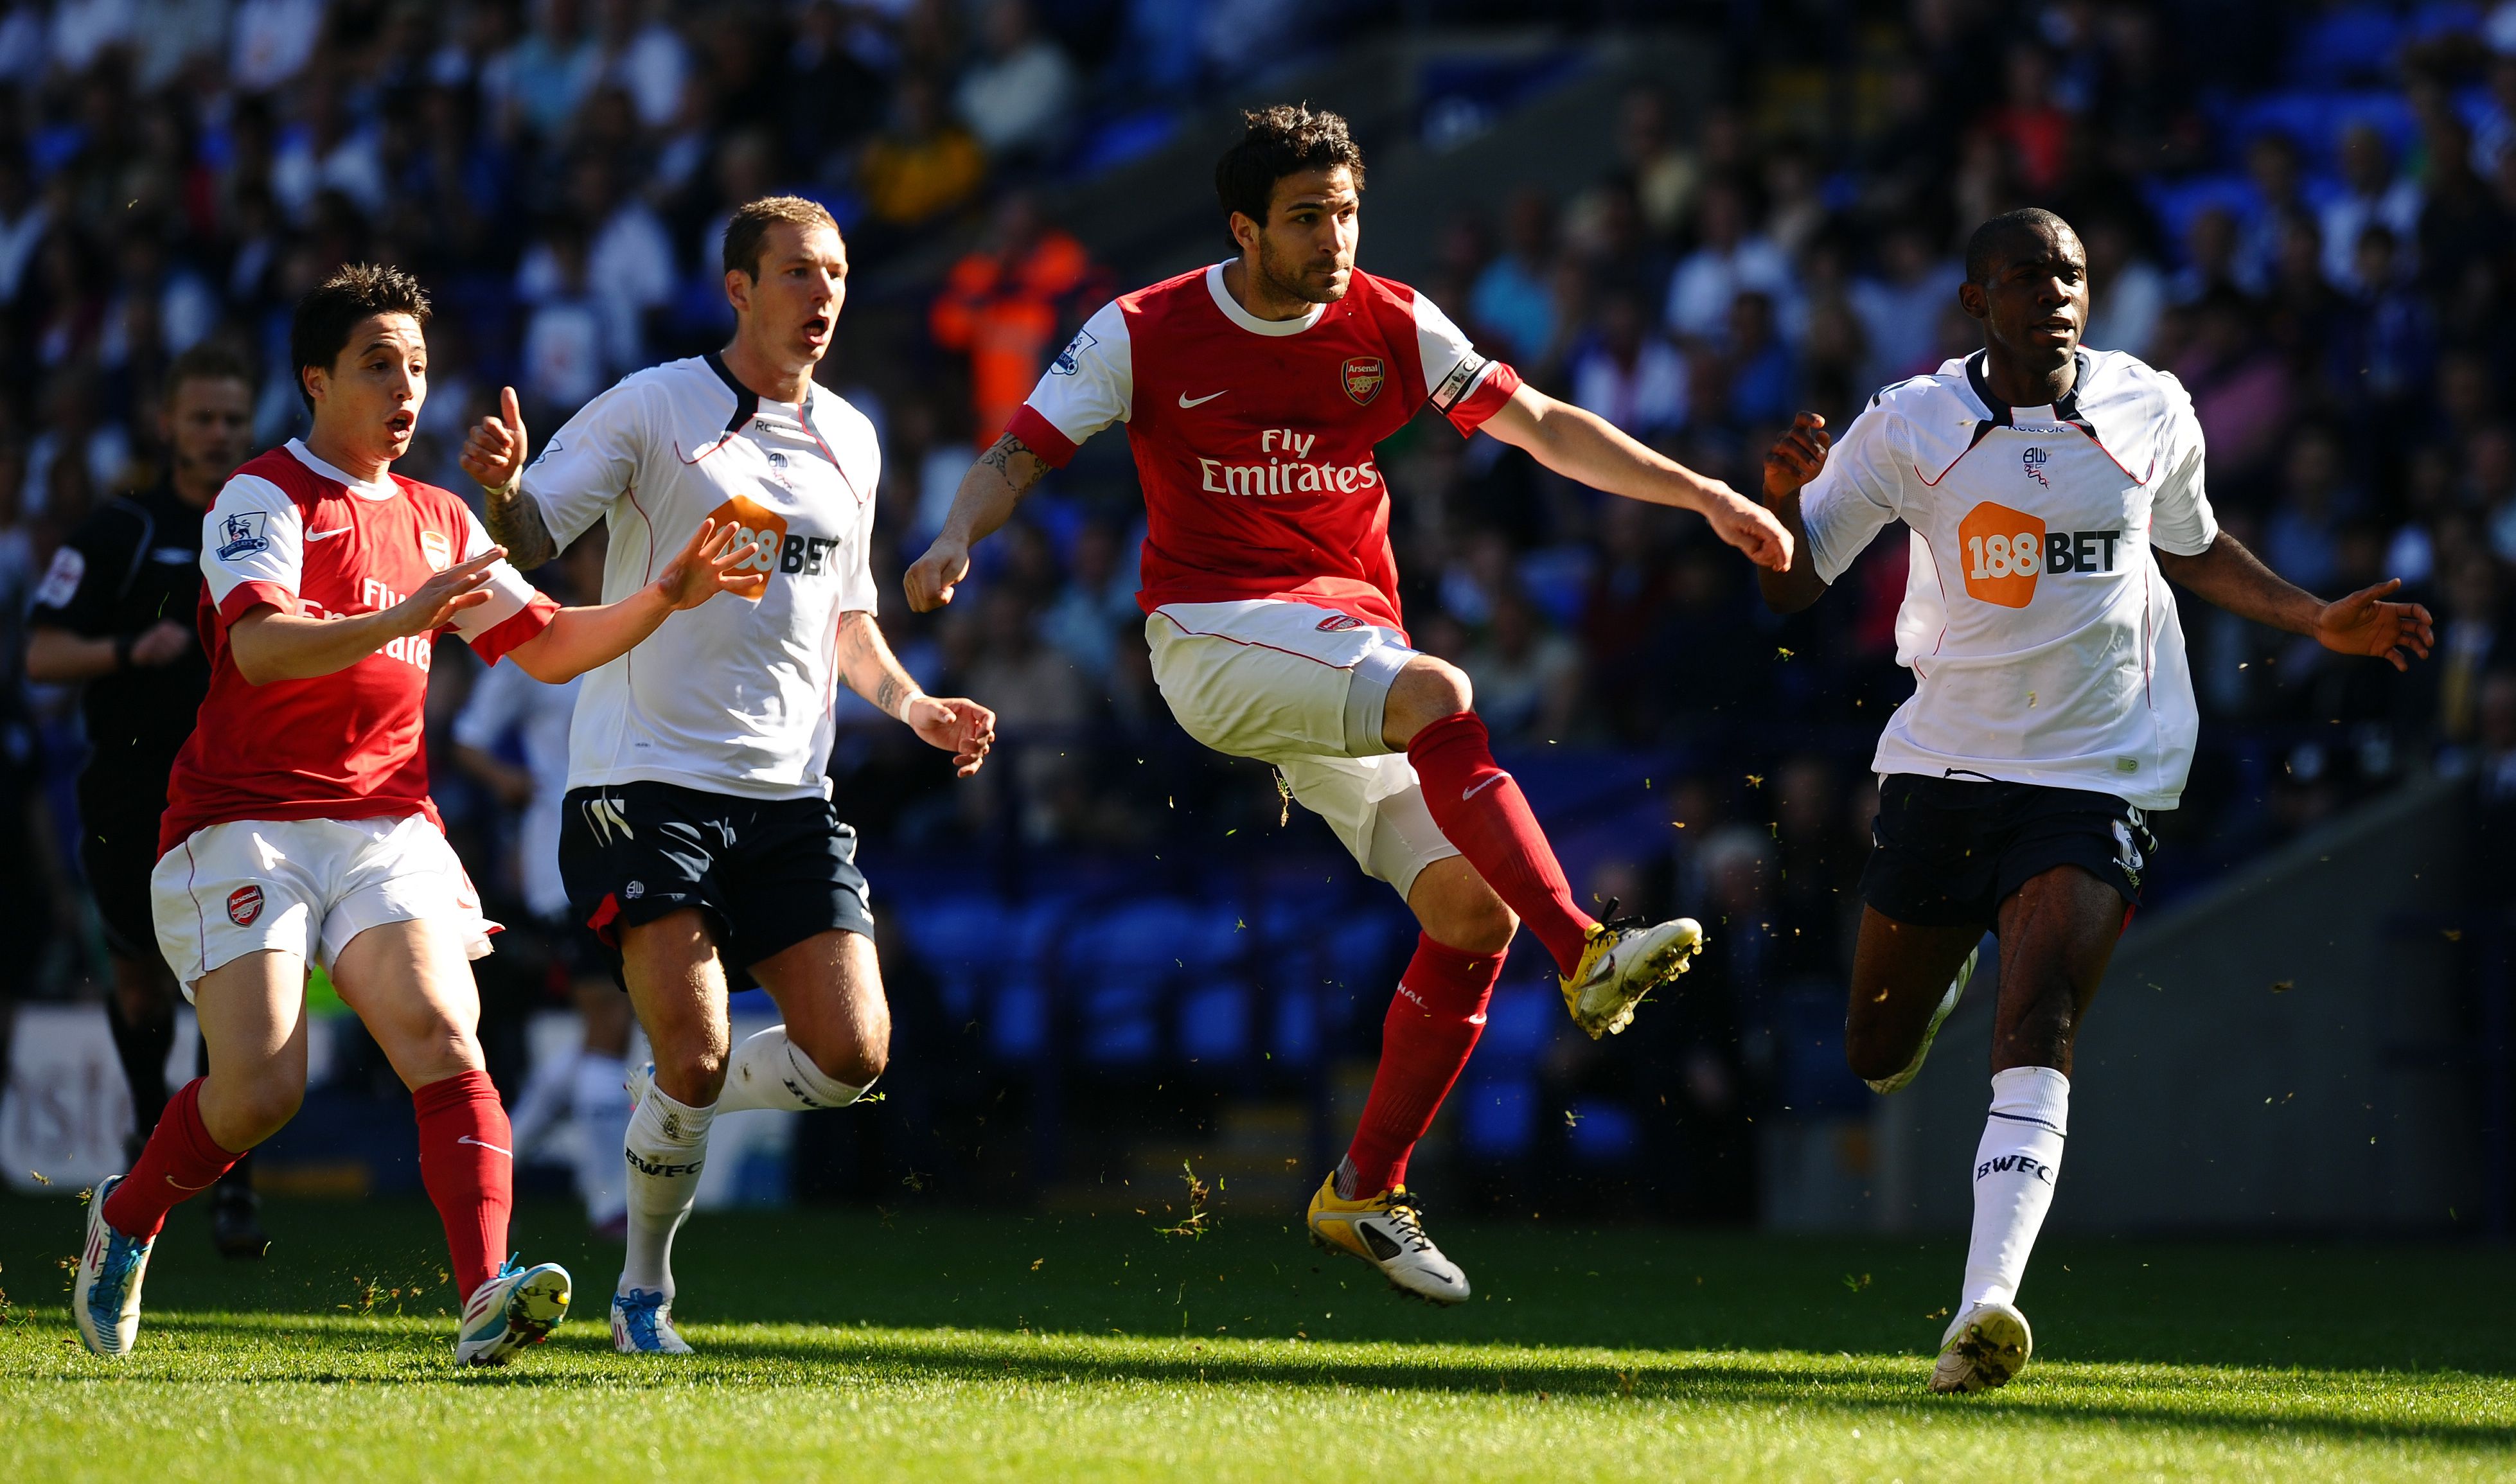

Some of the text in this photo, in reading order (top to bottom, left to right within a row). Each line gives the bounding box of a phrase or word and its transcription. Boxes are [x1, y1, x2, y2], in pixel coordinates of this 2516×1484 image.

[1348, 364, 1378, 373] Arsenal
[1262, 428, 1315, 459] Fly
[1197, 457, 1378, 495] Emirates
[1968, 531, 2120, 579] 188BET
[231, 890, 258, 906] Arsenal
[625, 1145, 702, 1178] BWFC
[1976, 1154, 2053, 1186] BWFC
